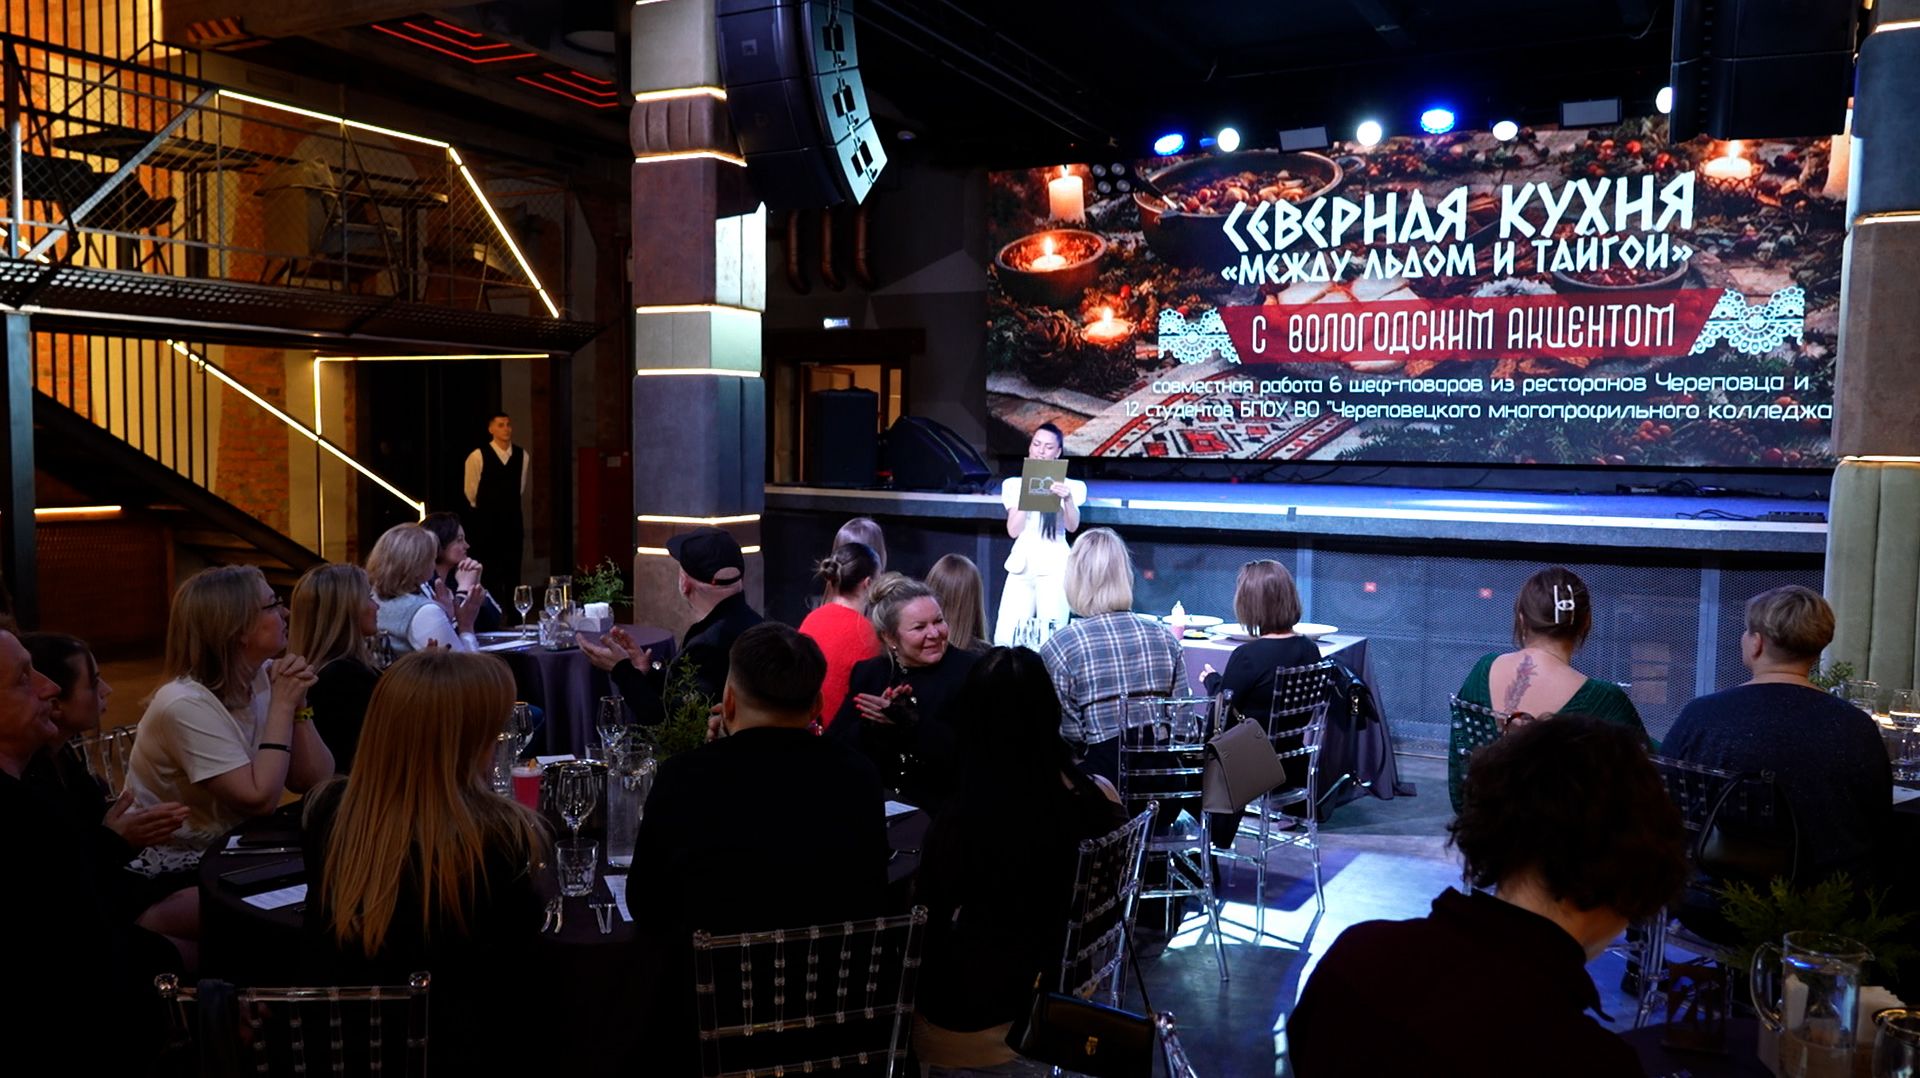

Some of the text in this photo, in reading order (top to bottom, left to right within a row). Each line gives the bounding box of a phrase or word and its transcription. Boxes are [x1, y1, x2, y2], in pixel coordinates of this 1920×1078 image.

[1222, 170, 1697, 252] СЕВЕРНАЯ КУХНЯ
[1221, 249, 1353, 286] «МЕЖДУ
[1362, 242, 1477, 281] ЛЬДОМ
[1493, 240, 1516, 277] И
[1252, 303, 1675, 355] С ВОЛОГОДСКИМ АКЦЕНТОМ
[1152, 372, 1810, 397] совместная работа 6 шеф-поваров из ресторанов Череповца и
[1124, 400, 1834, 423] 12 студентов БПОУ ВО "Череповецкого многопрофильного колледжа
